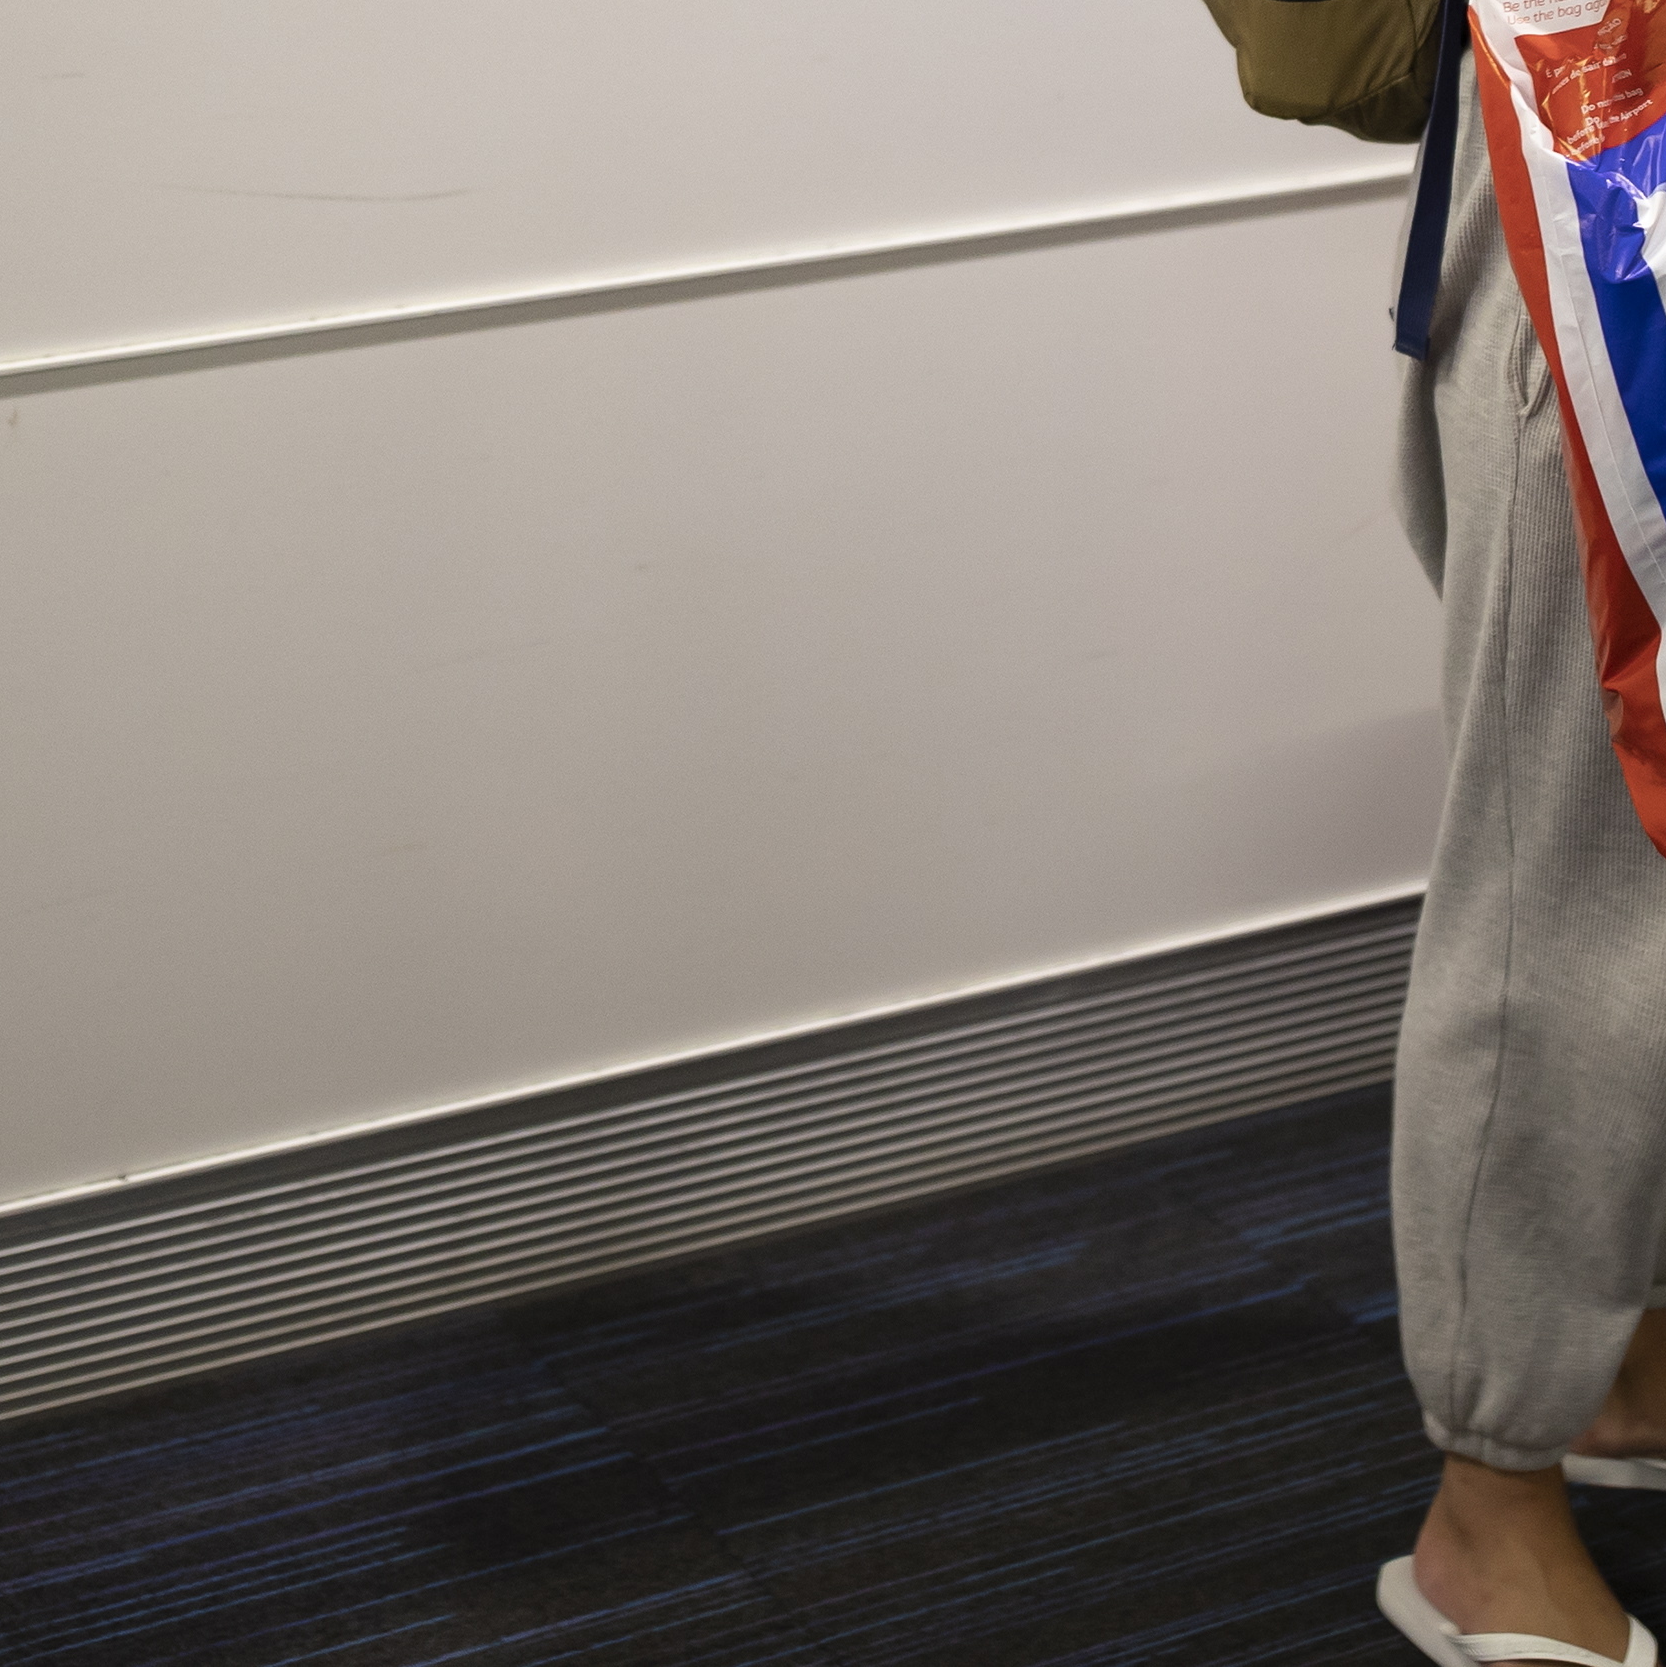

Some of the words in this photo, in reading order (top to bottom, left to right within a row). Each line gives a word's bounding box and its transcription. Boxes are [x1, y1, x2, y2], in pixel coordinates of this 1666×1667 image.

[1503, 1, 1521, 13] Be
[1507, 15, 1531, 26] Use
[1533, 9, 1555, 23] the
[1557, 3, 1582, 17] bag
[1620, 99, 1654, 121] Airport
